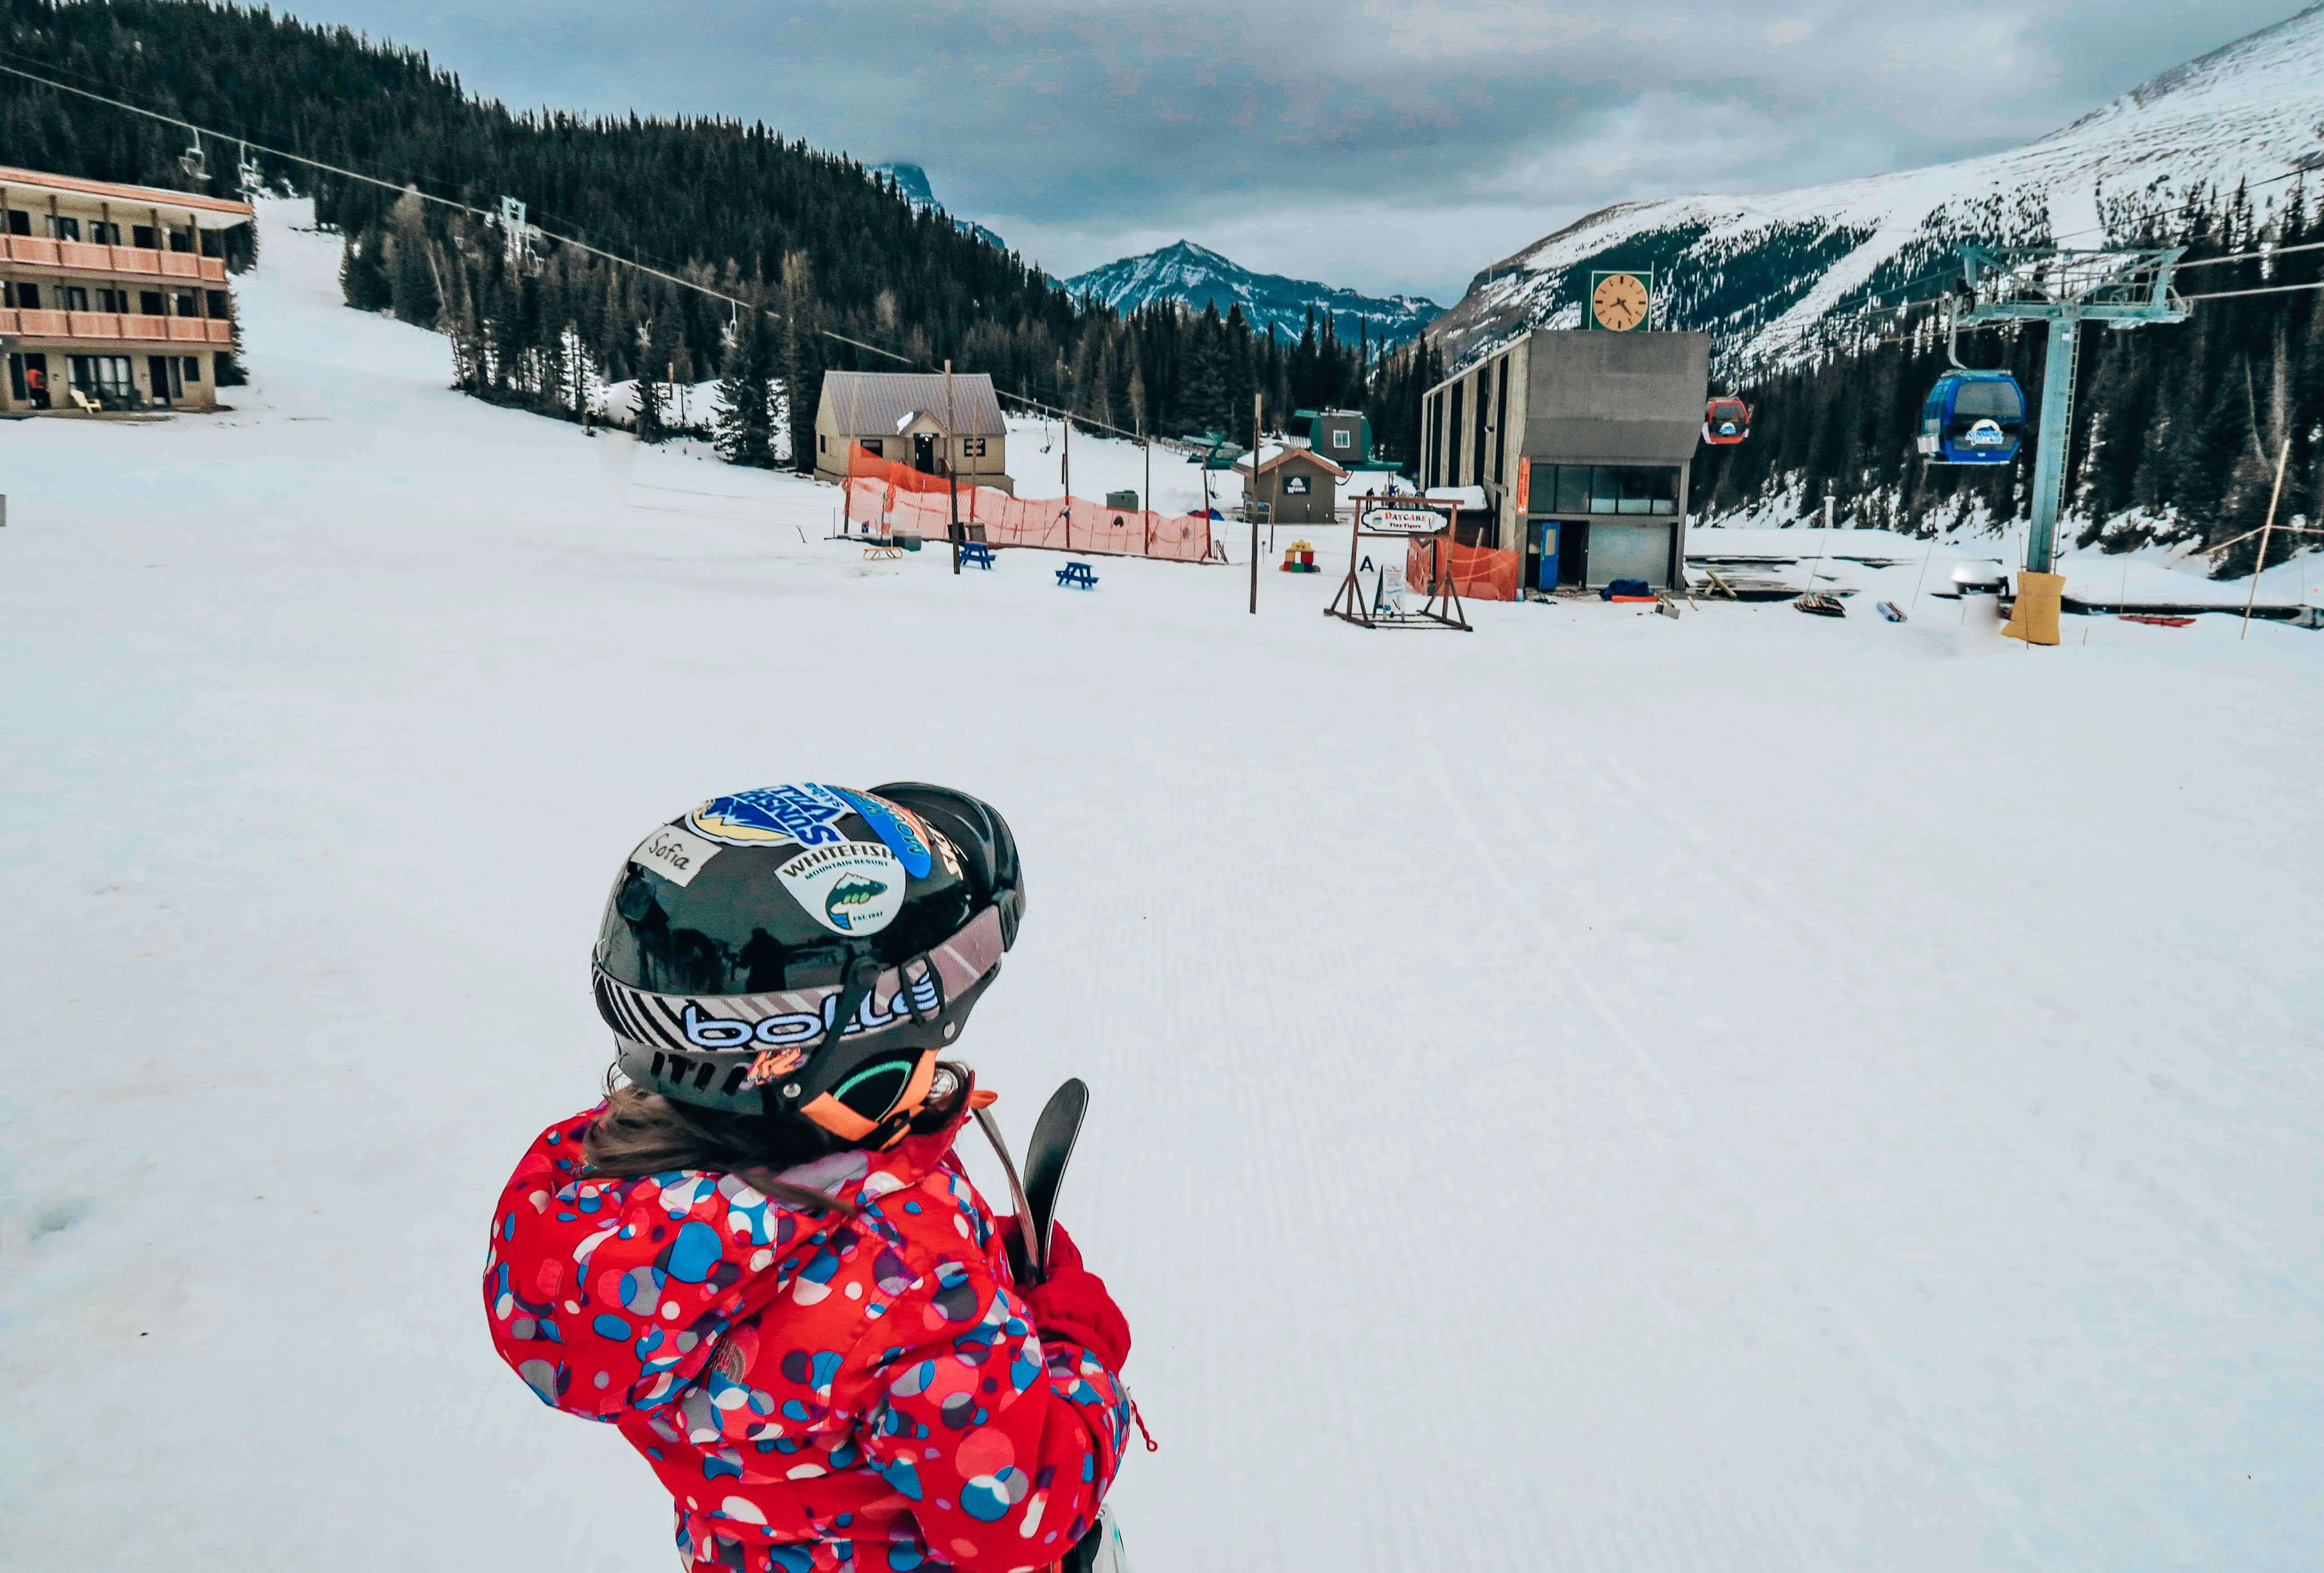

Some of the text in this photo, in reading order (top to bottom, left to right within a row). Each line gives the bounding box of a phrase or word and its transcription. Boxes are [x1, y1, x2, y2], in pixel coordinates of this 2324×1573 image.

[1385, 512, 1428, 522] DAYCARE
[649, 833, 690, 870] Sofia
[782, 844, 896, 878] WHITEFISH
[804, 859, 888, 880] MOUNTAIN RESORT
